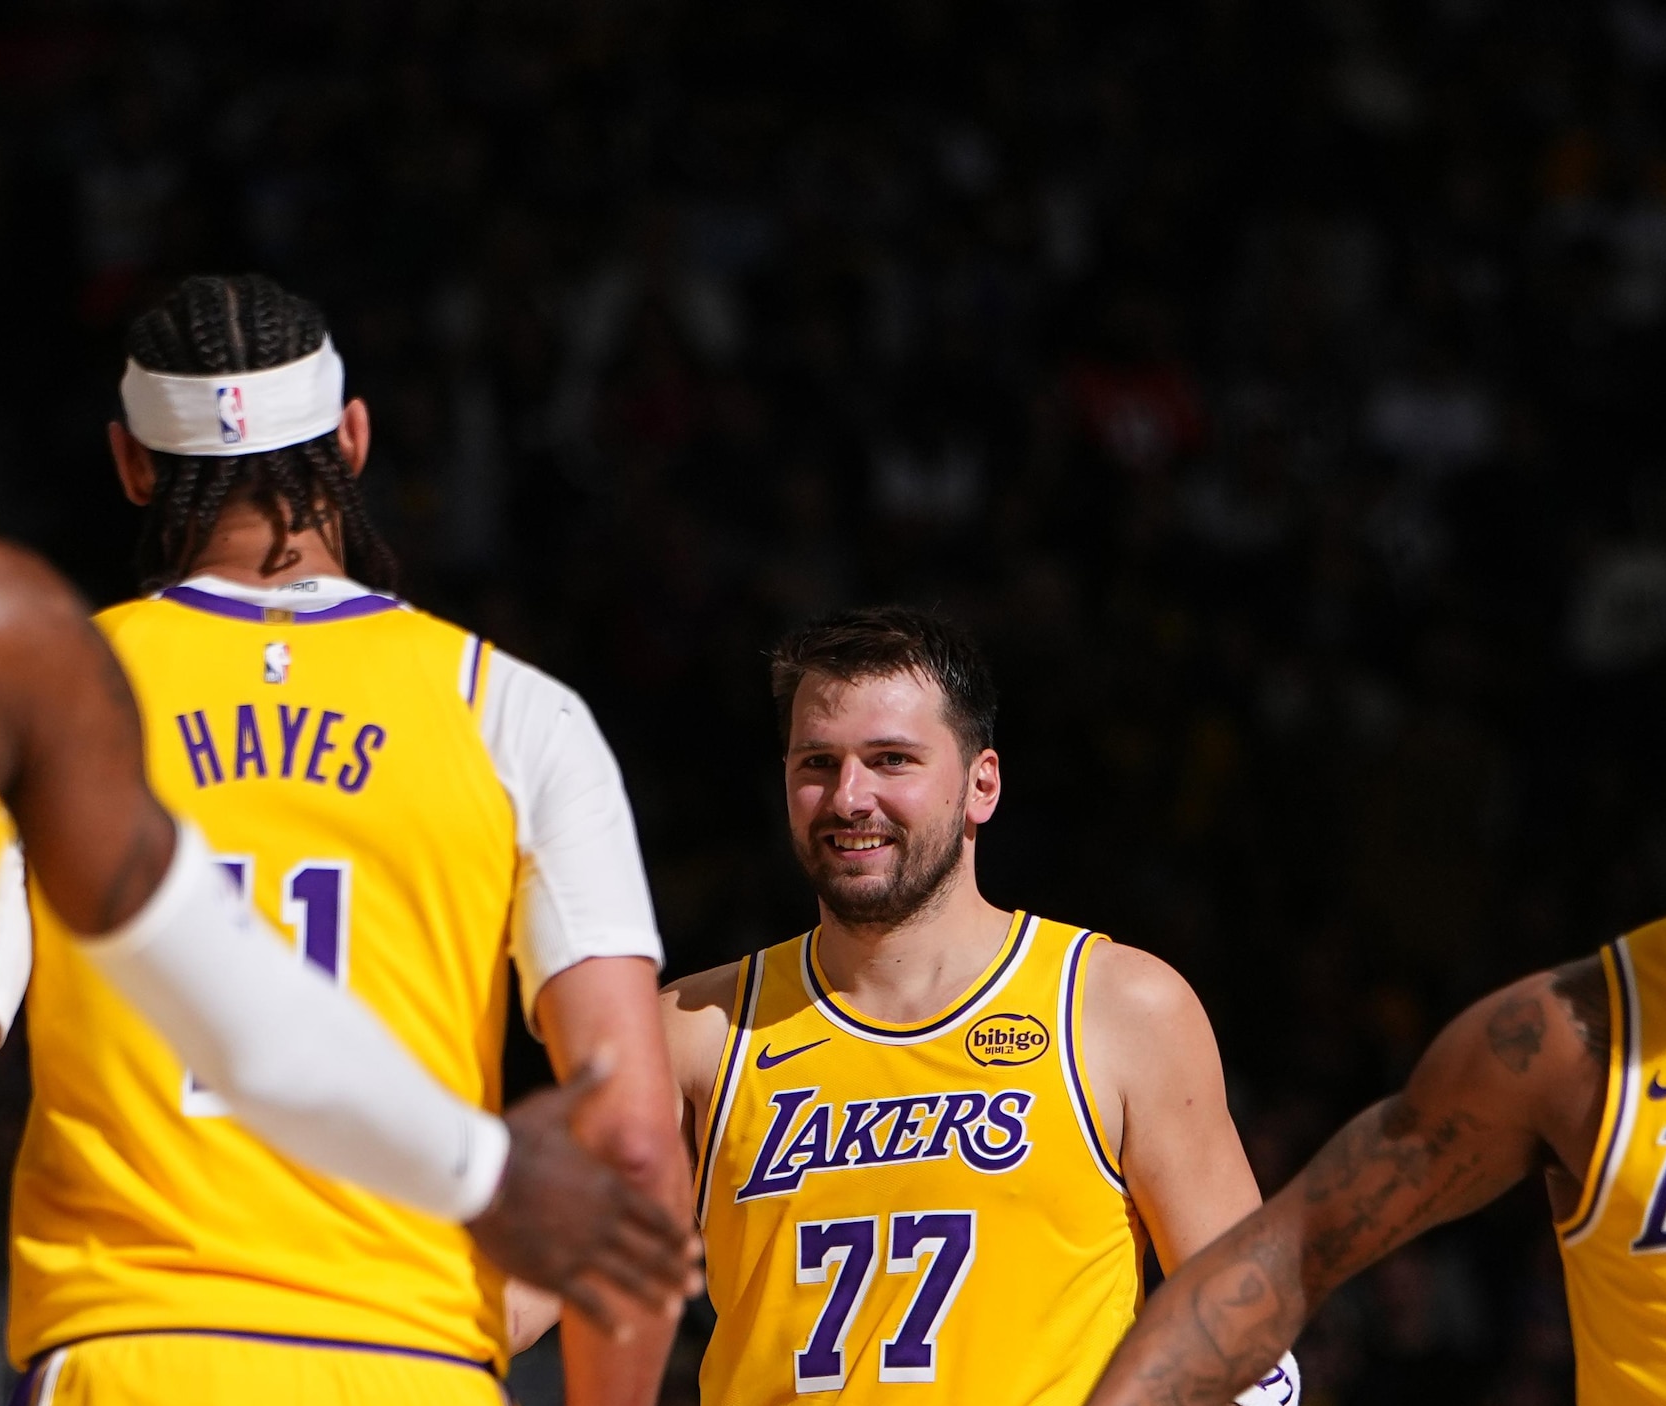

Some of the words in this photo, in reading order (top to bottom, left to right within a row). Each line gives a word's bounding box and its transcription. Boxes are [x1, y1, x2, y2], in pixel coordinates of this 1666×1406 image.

[174, 703, 386, 795] HAYES
[973, 1027, 1045, 1051] bibigo
[984, 1045, 1015, 1056] 비비고
[734, 1086, 1036, 1204] LAKERS
[794, 1209, 977, 1394] 77
